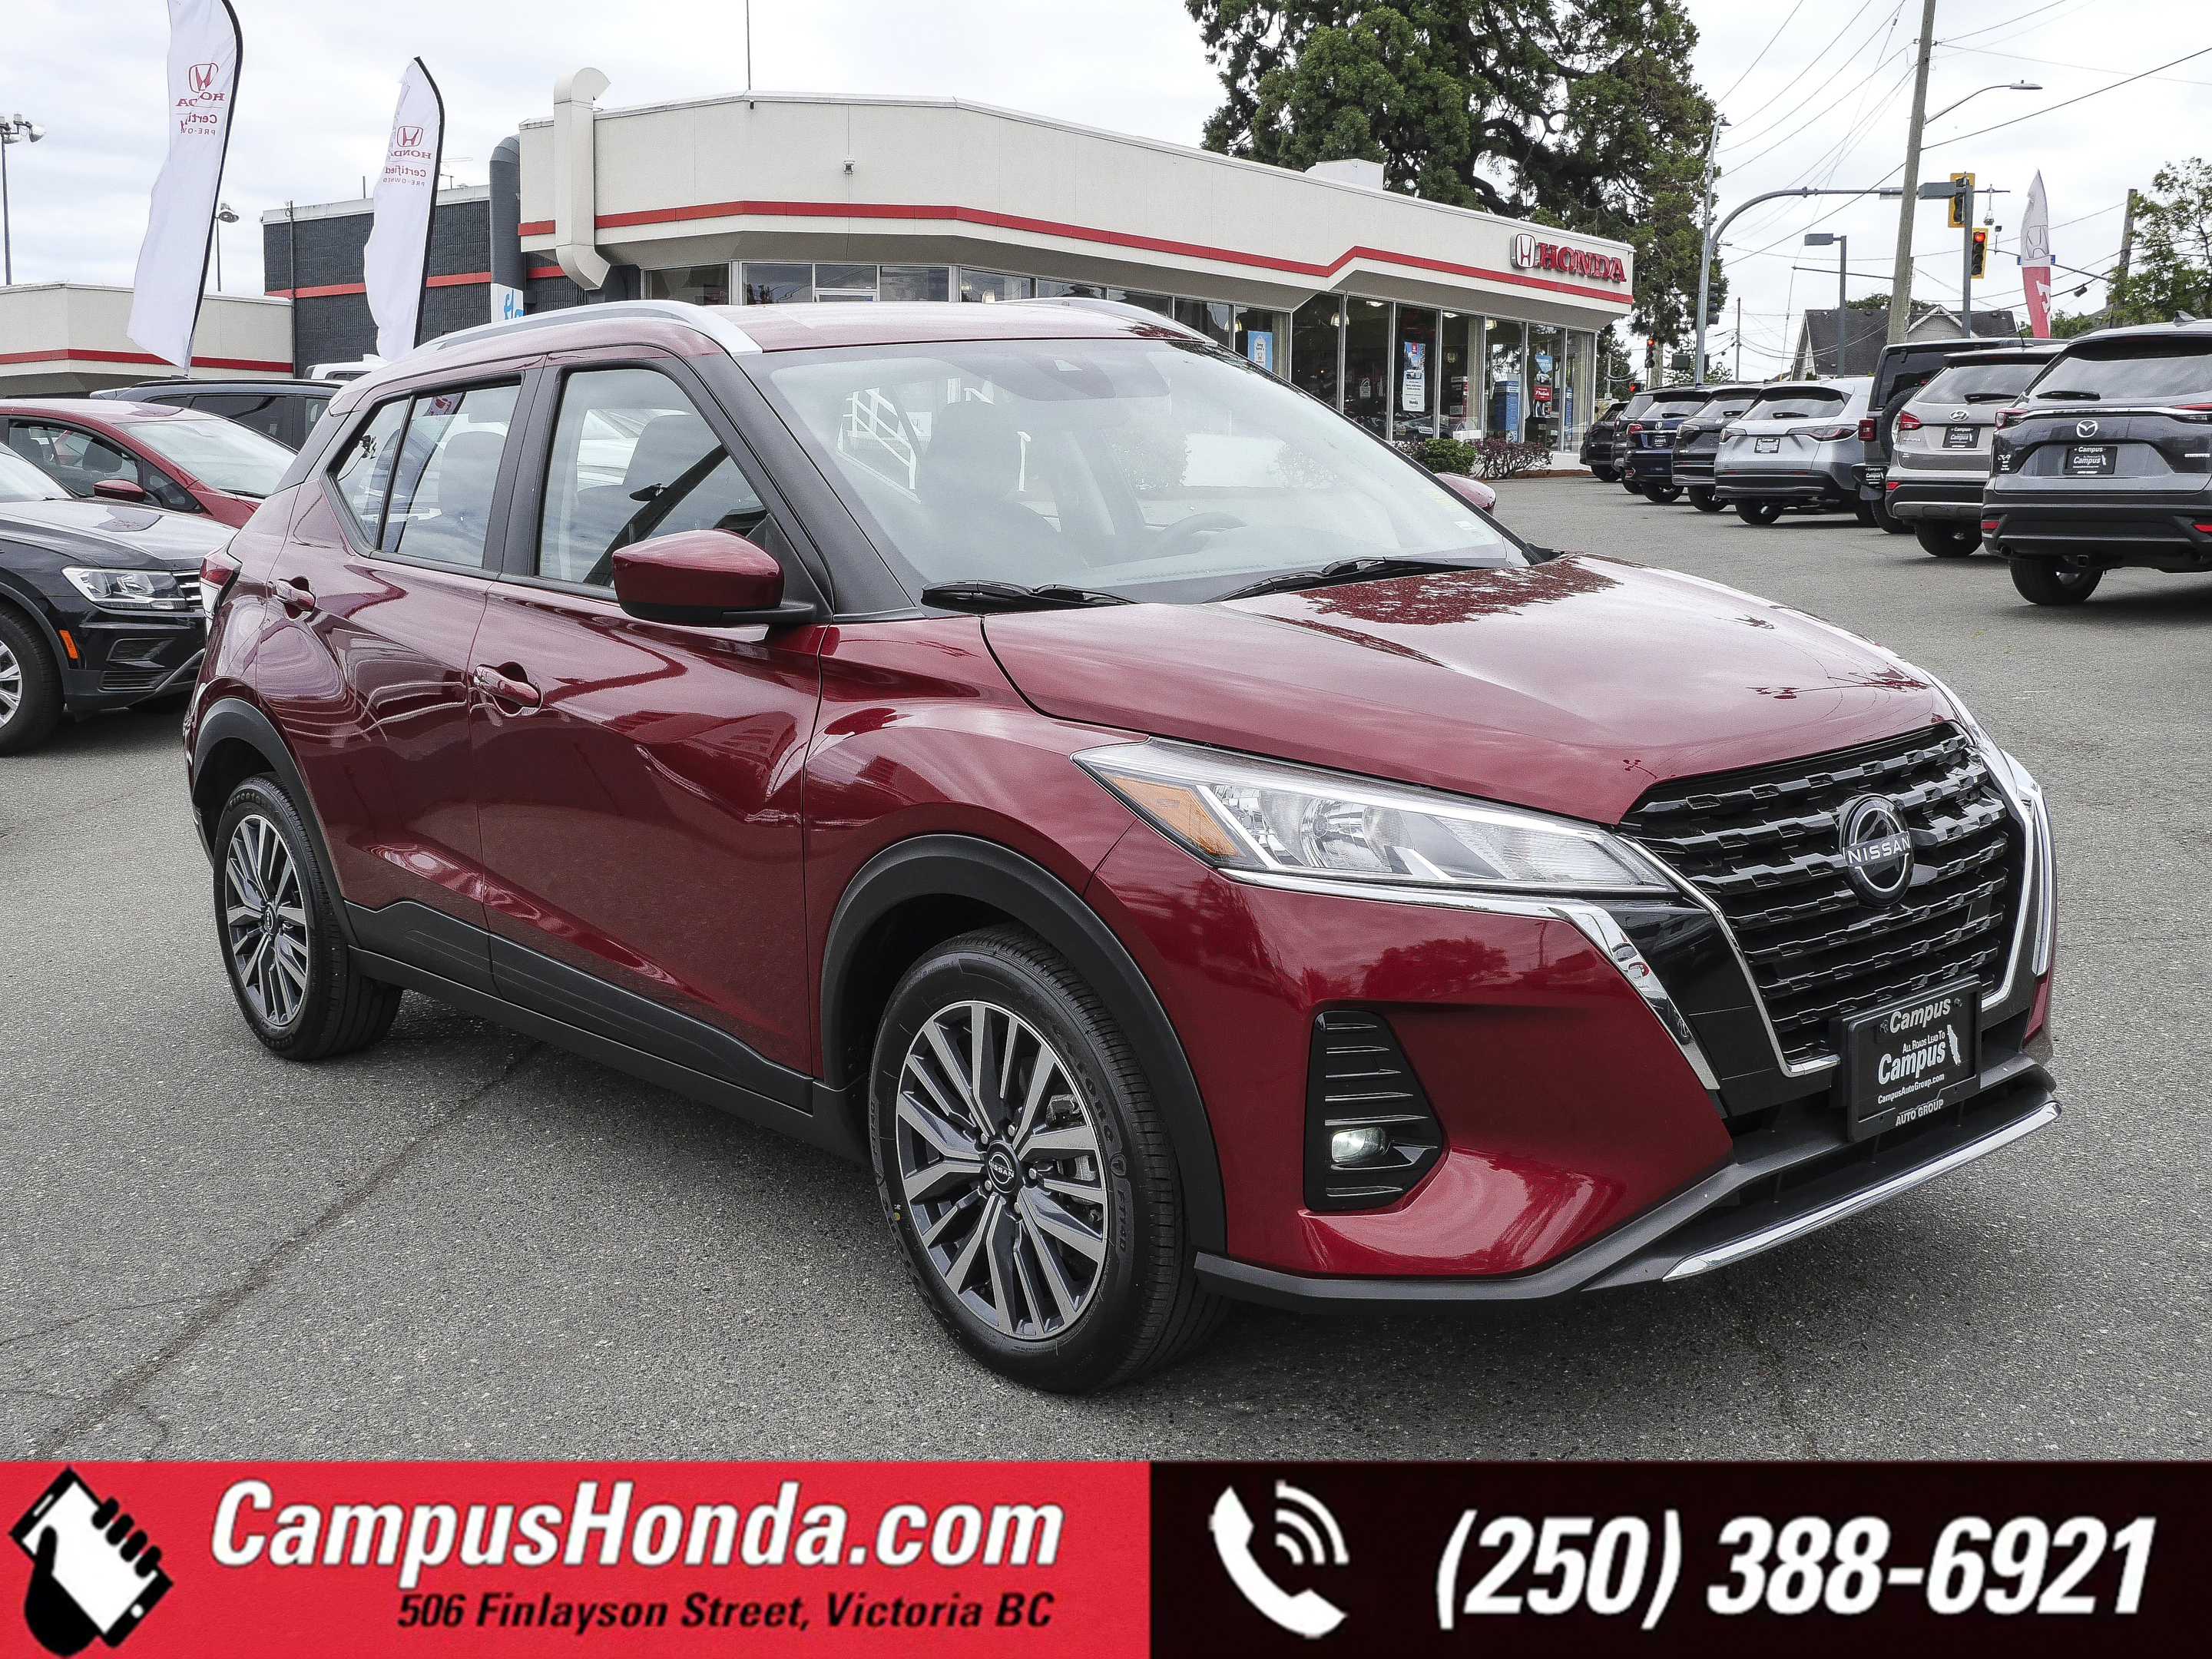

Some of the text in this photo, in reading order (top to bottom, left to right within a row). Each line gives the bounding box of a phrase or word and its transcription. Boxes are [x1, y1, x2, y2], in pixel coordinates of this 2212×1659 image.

[1538, 242, 1627, 283] HONDA
[2073, 456, 2101, 465] Campus
[1847, 835, 1911, 864] NISSAN
[1889, 998, 1951, 1034] Campus
[1878, 1041, 1946, 1085] Campus
[1878, 1073, 1945, 1104] CampusAutoGroup.com
[1896, 1098, 1944, 1127] AUTO GROUP
[988, 1160, 1015, 1178] NISSAN
